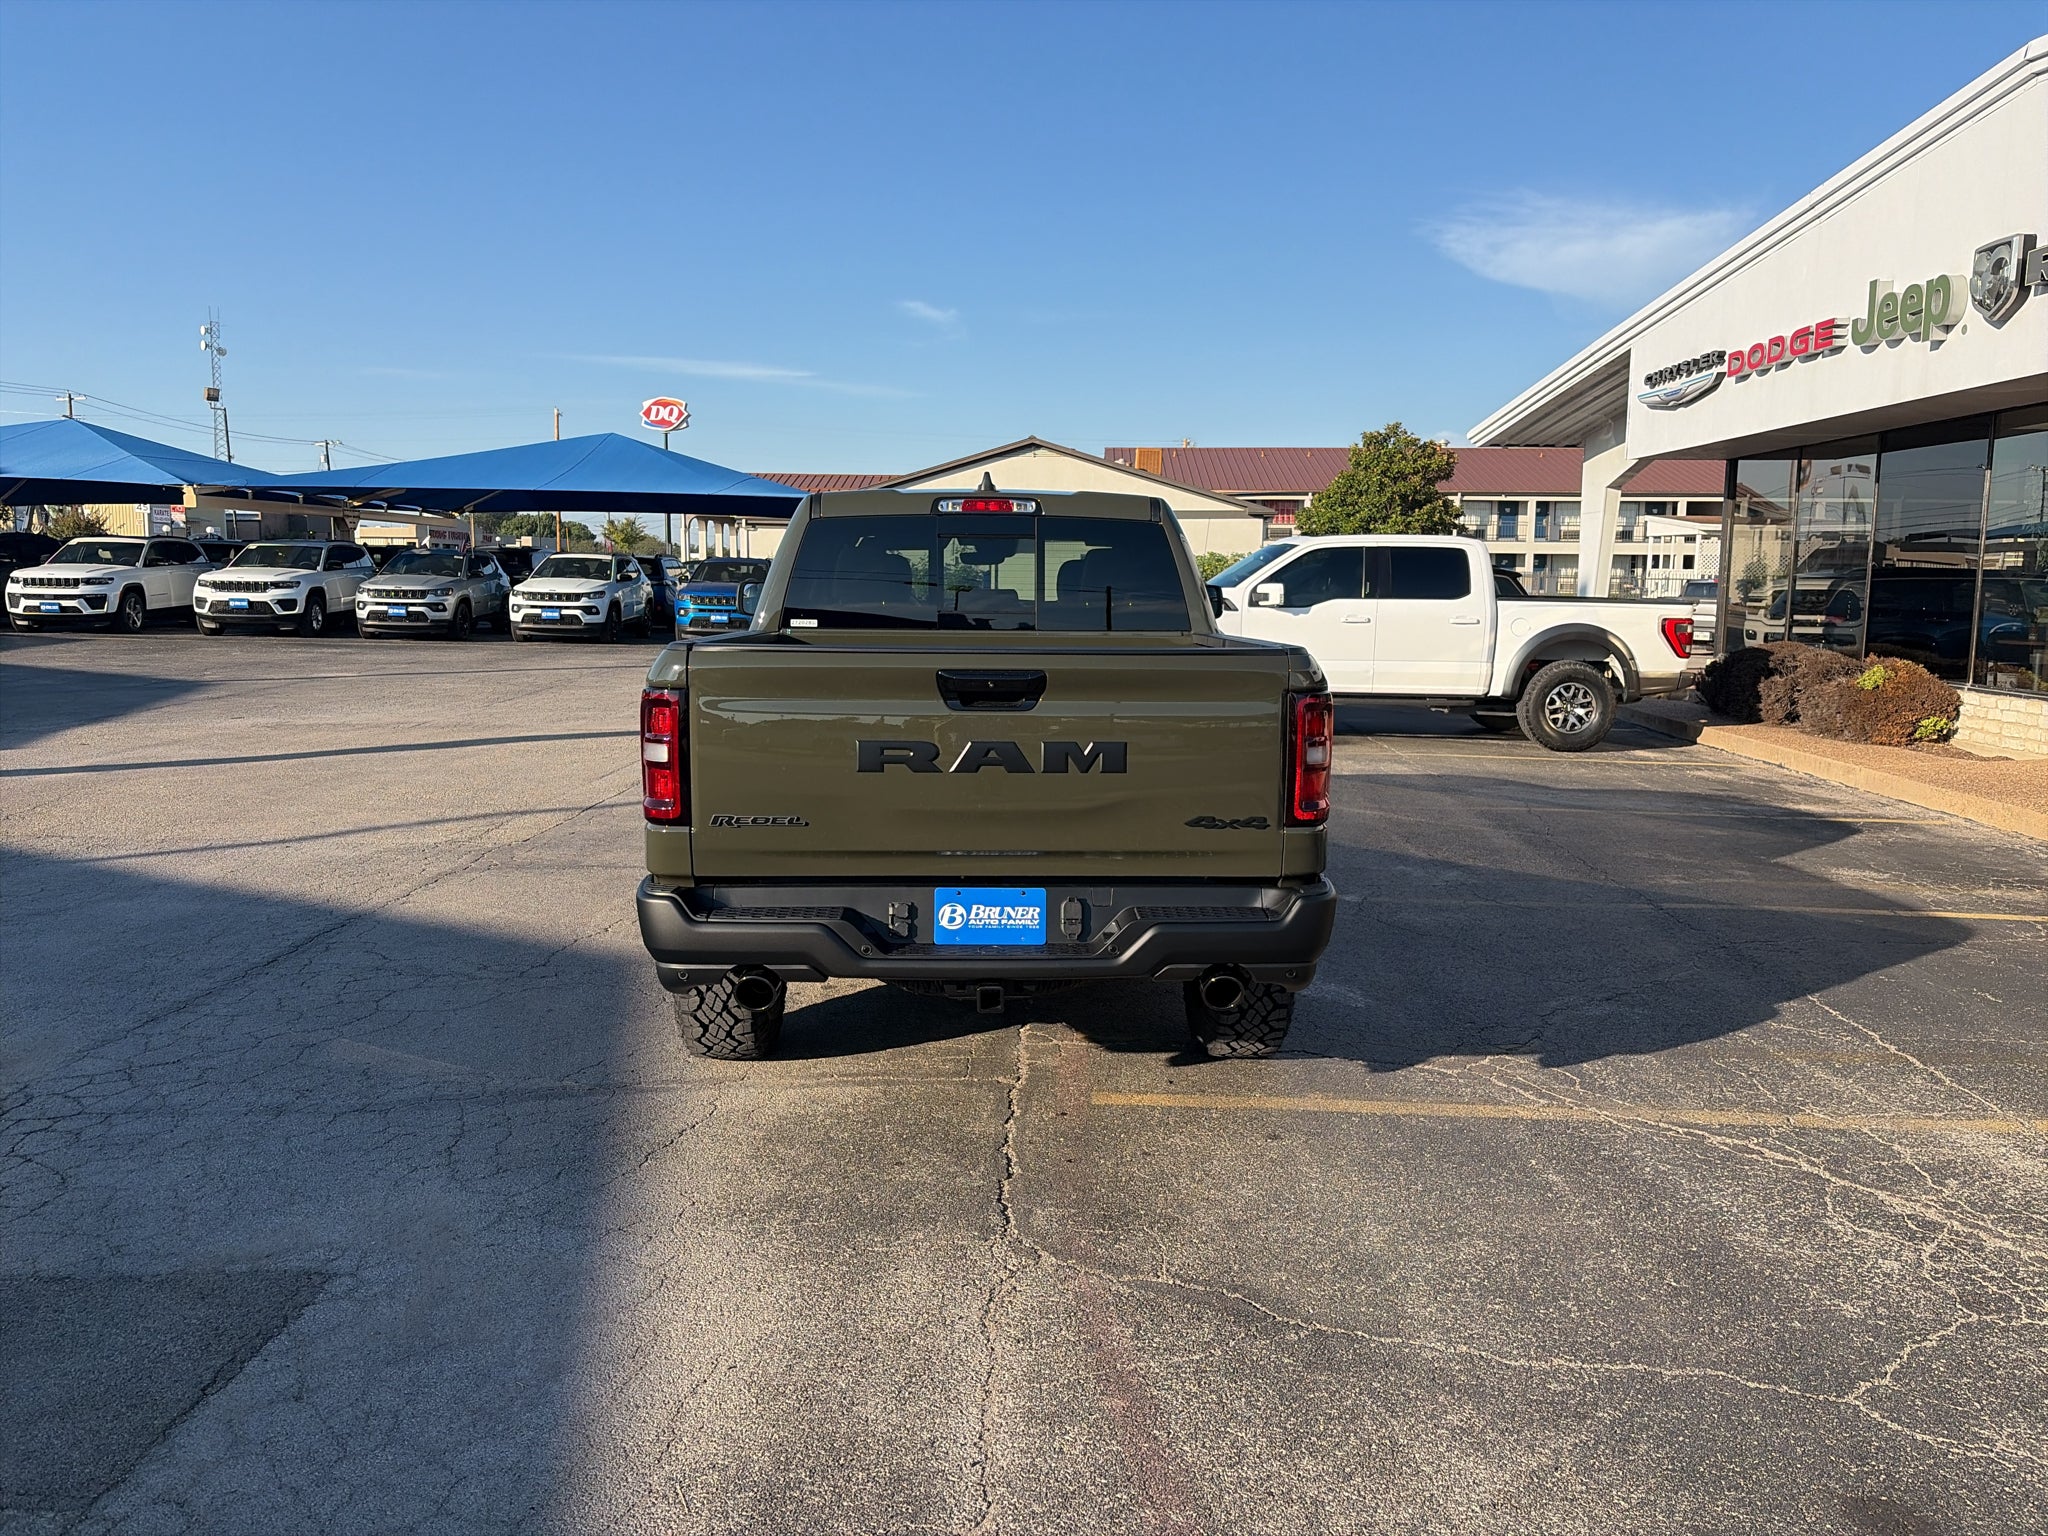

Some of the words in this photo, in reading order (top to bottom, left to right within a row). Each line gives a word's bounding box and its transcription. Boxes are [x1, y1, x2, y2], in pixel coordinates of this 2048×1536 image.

[1851, 274, 1954, 347] Jeep
[1727, 317, 1837, 378] DODGE
[1644, 351, 1724, 387] CHRYSLER
[649, 405, 679, 423] DQ
[856, 739, 1128, 774] RAM
[708, 814, 809, 828] REBEL
[1184, 815, 1271, 830] 4x4
[968, 904, 1041, 919] BRUNER
